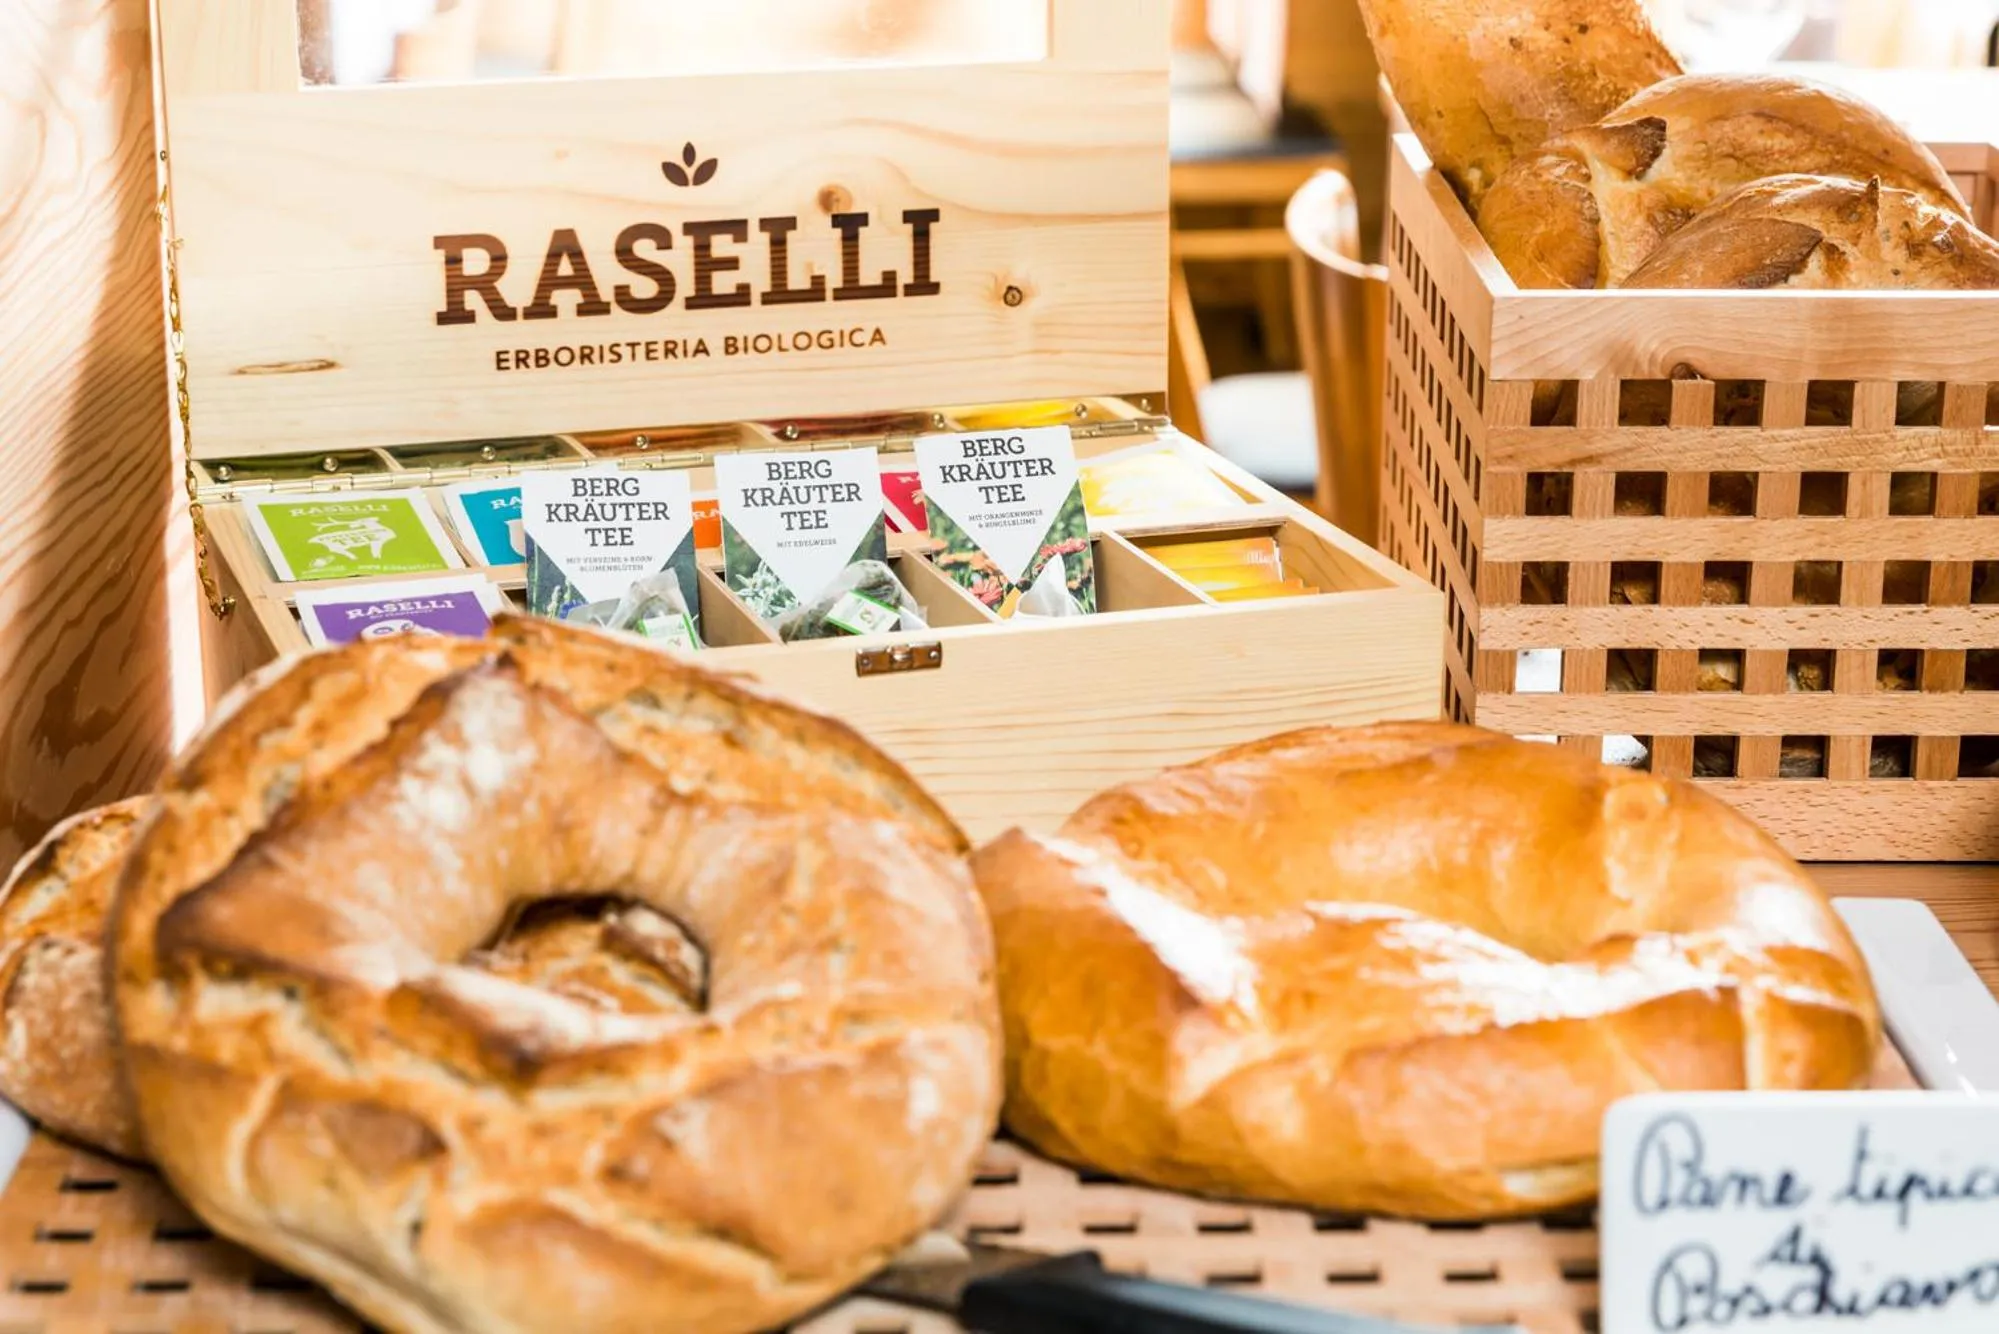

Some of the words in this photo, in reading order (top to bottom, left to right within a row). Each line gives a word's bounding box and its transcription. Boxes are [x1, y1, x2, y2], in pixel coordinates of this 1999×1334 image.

[434, 208, 941, 325] RASELLI
[496, 337, 711, 371] ERBORISTERIA
[724, 327, 888, 357] BIOLOGICA
[961, 436, 1025, 458] BERG
[765, 459, 832, 481] BERG
[939, 457, 1056, 484] KRÄUTER
[571, 477, 640, 497] BERG
[741, 482, 862, 508] KRÄUTER
[978, 484, 1026, 504] TEE
[289, 504, 390, 516] RASELLI
[545, 498, 670, 523] KRÄUTER
[780, 510, 828, 531] TEE
[584, 527, 634, 547] TEE
[345, 600, 455, 619] RASELLI
